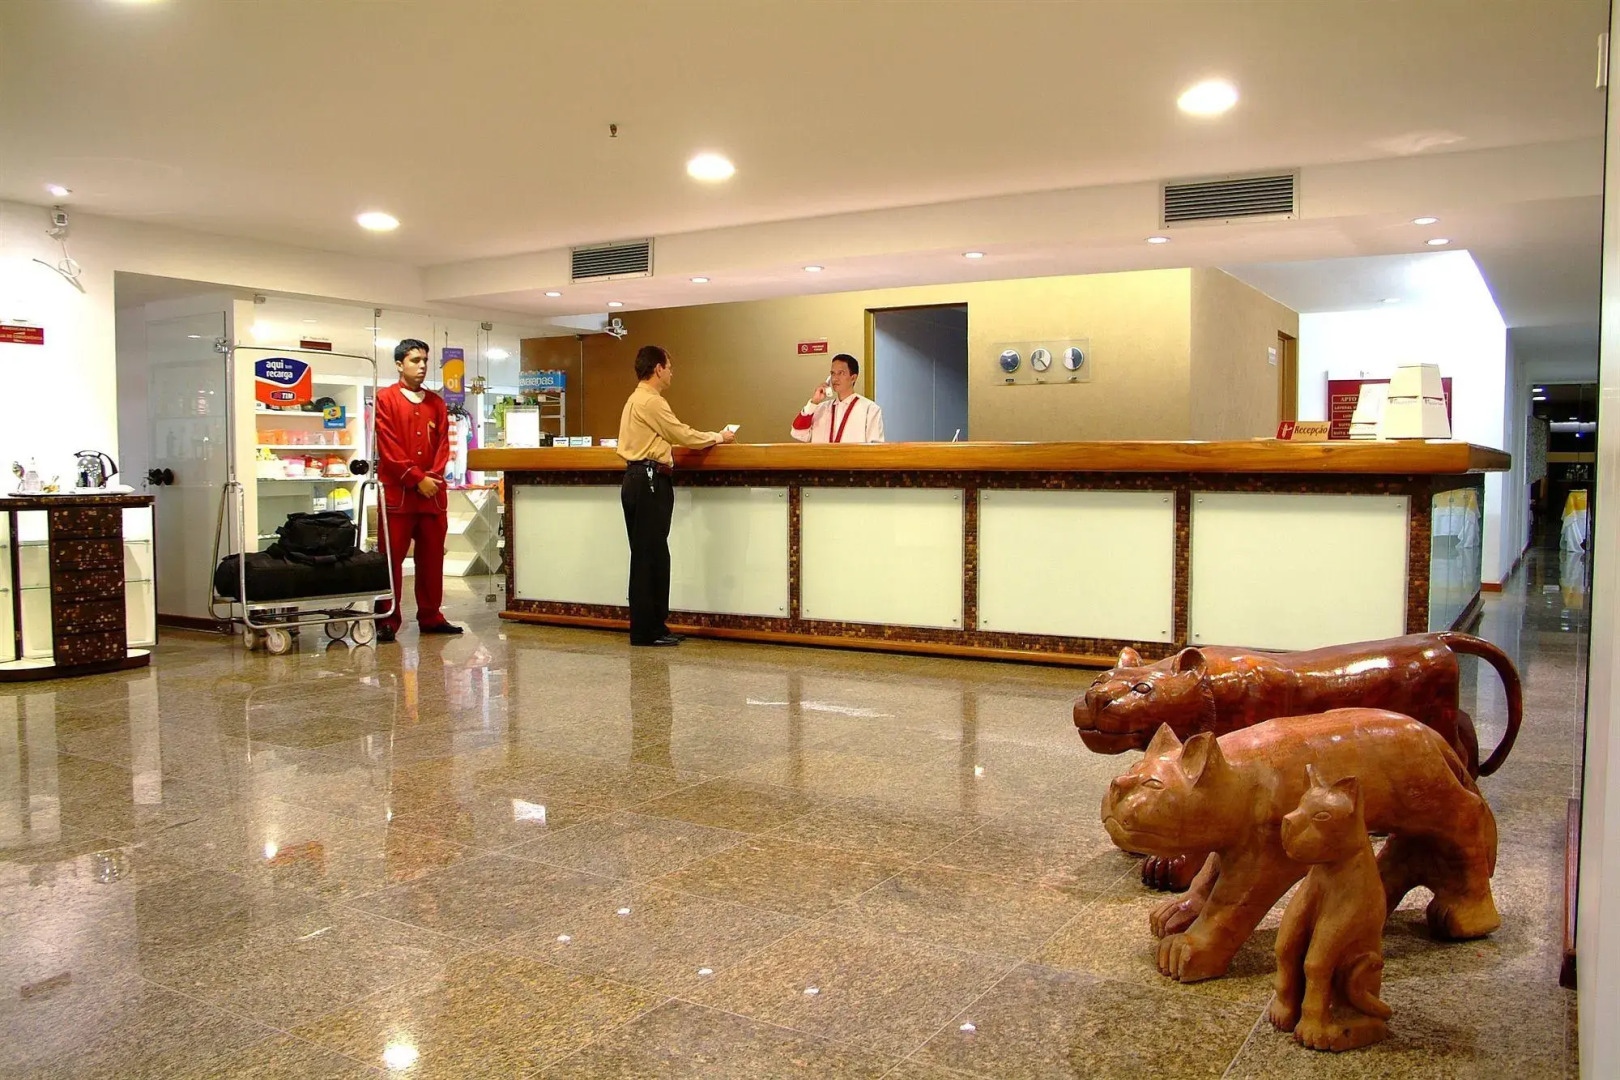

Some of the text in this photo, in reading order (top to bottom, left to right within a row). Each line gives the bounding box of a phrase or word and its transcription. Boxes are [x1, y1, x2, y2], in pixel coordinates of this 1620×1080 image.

[266, 360, 284, 370] aqui
[266, 371, 293, 380] recarga
[446, 374, 458, 389] oi
[1294, 425, 1328, 436] Recepção
